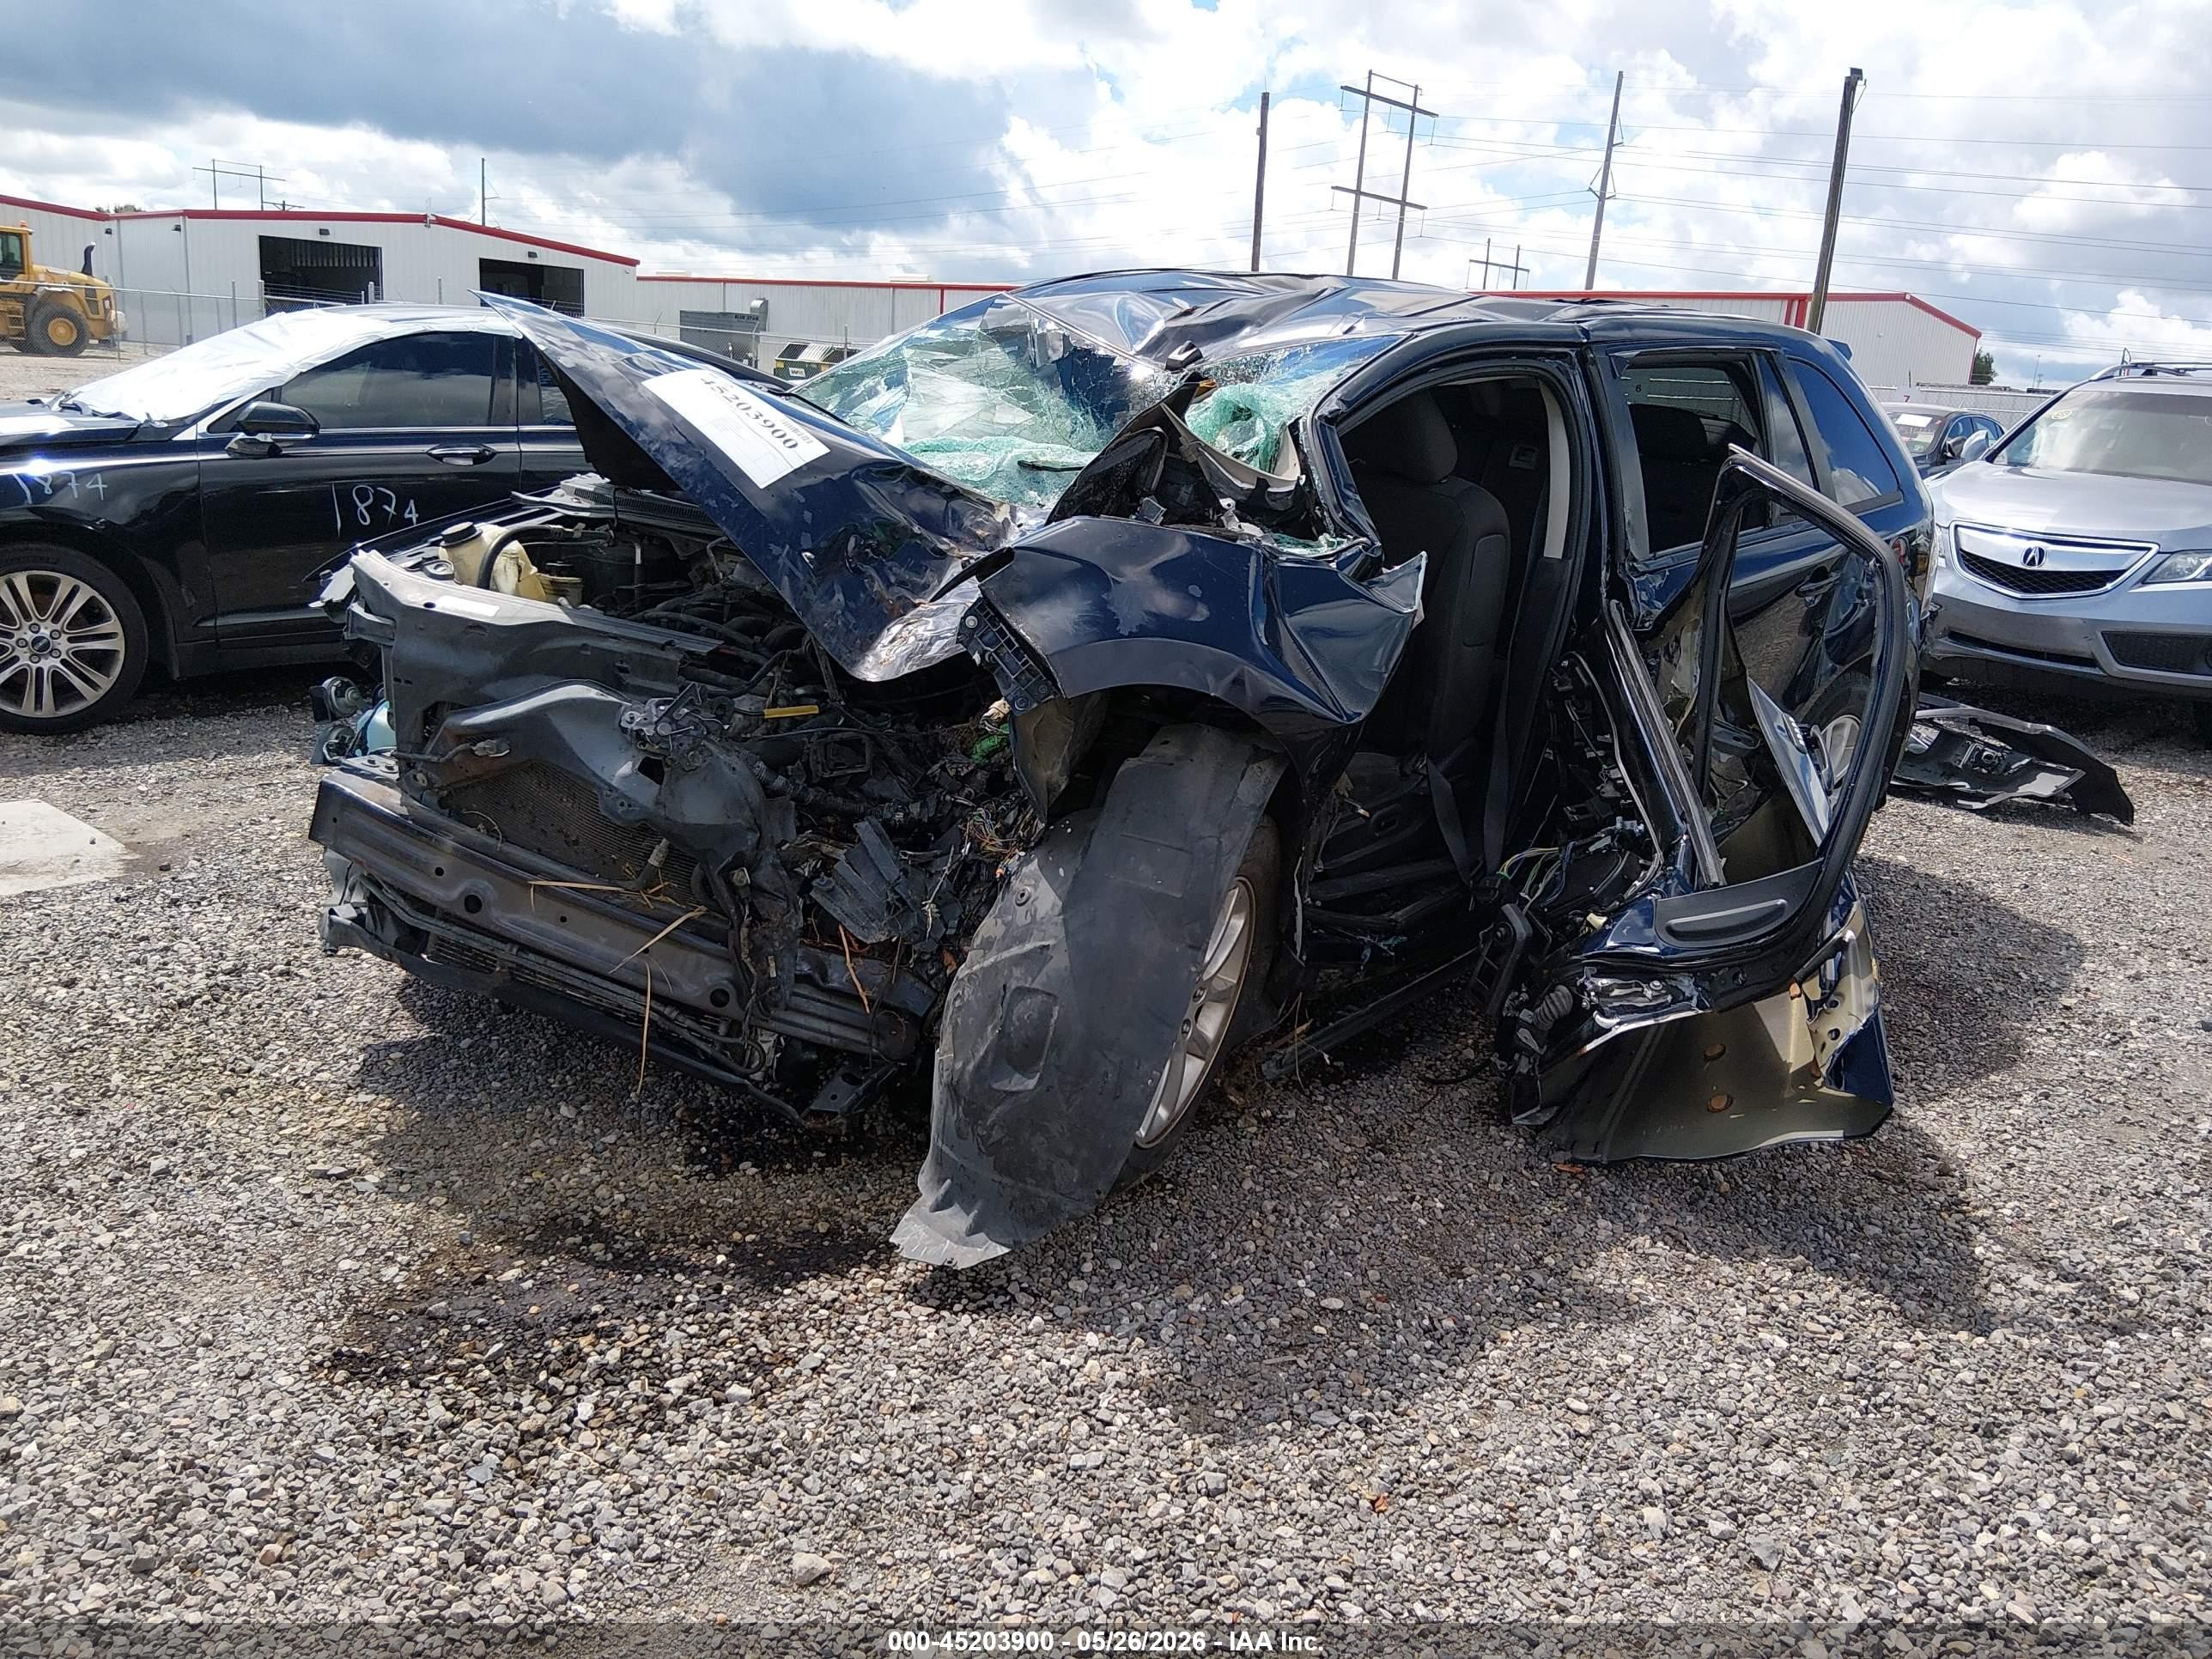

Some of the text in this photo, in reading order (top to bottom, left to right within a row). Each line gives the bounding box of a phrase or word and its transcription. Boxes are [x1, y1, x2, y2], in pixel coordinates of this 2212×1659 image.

[1635, 384, 1642, 392] 6
[700, 377, 799, 449] 45203900
[12, 471, 108, 505] 1874
[331, 483, 419, 537] 1874
